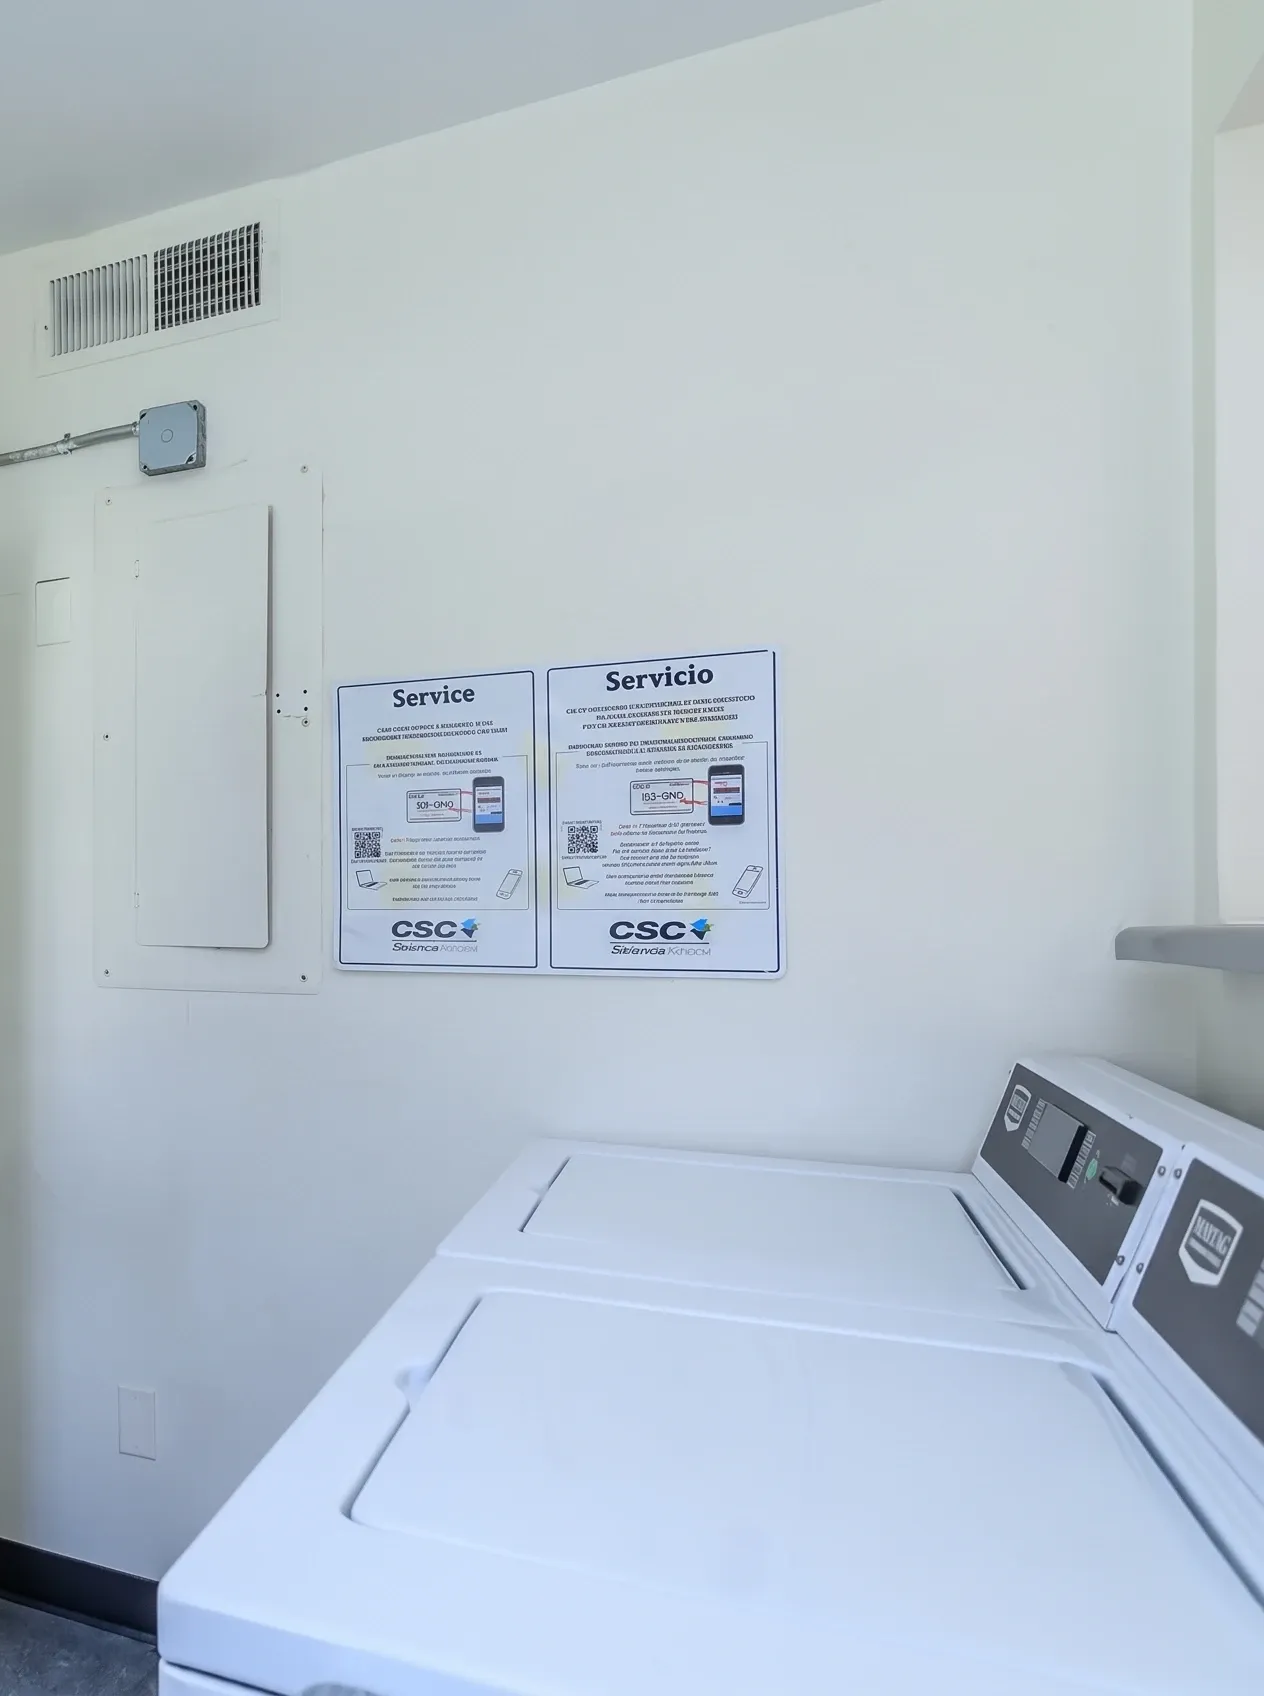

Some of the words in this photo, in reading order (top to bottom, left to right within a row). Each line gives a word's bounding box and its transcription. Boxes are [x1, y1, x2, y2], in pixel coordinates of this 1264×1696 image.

[605, 663, 714, 692] Servicio
[392, 684, 476, 708] Service
[391, 920, 458, 939] CSC
[609, 920, 687, 941] CSC
